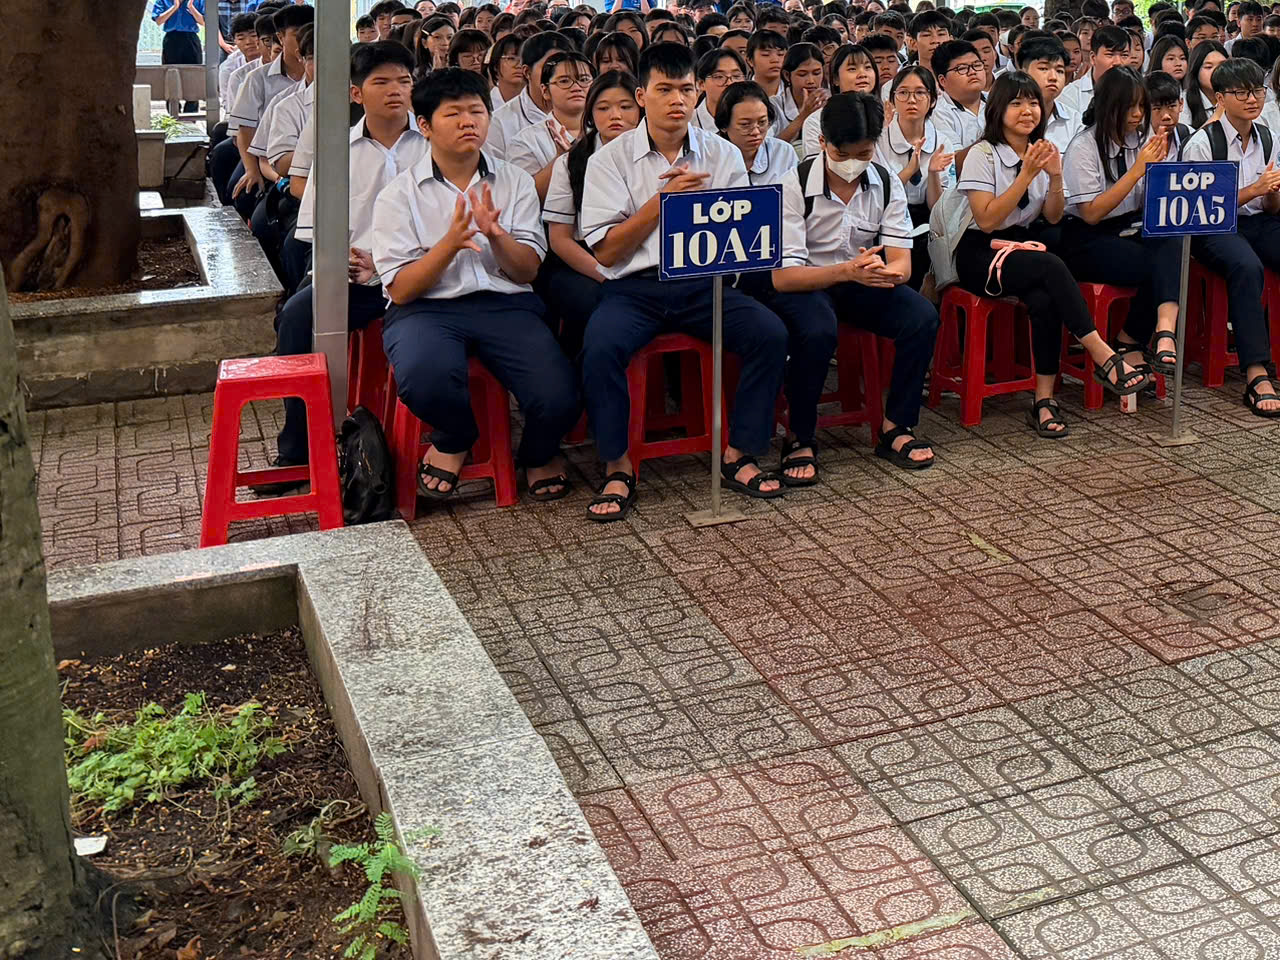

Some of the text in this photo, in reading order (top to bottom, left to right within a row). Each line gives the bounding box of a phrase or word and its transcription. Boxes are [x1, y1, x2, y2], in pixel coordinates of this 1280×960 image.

[1169, 167, 1215, 191] LỚP
[693, 196, 752, 224] LỚP
[1155, 195, 1226, 227] 10A5
[668, 224, 776, 269] 10A4
